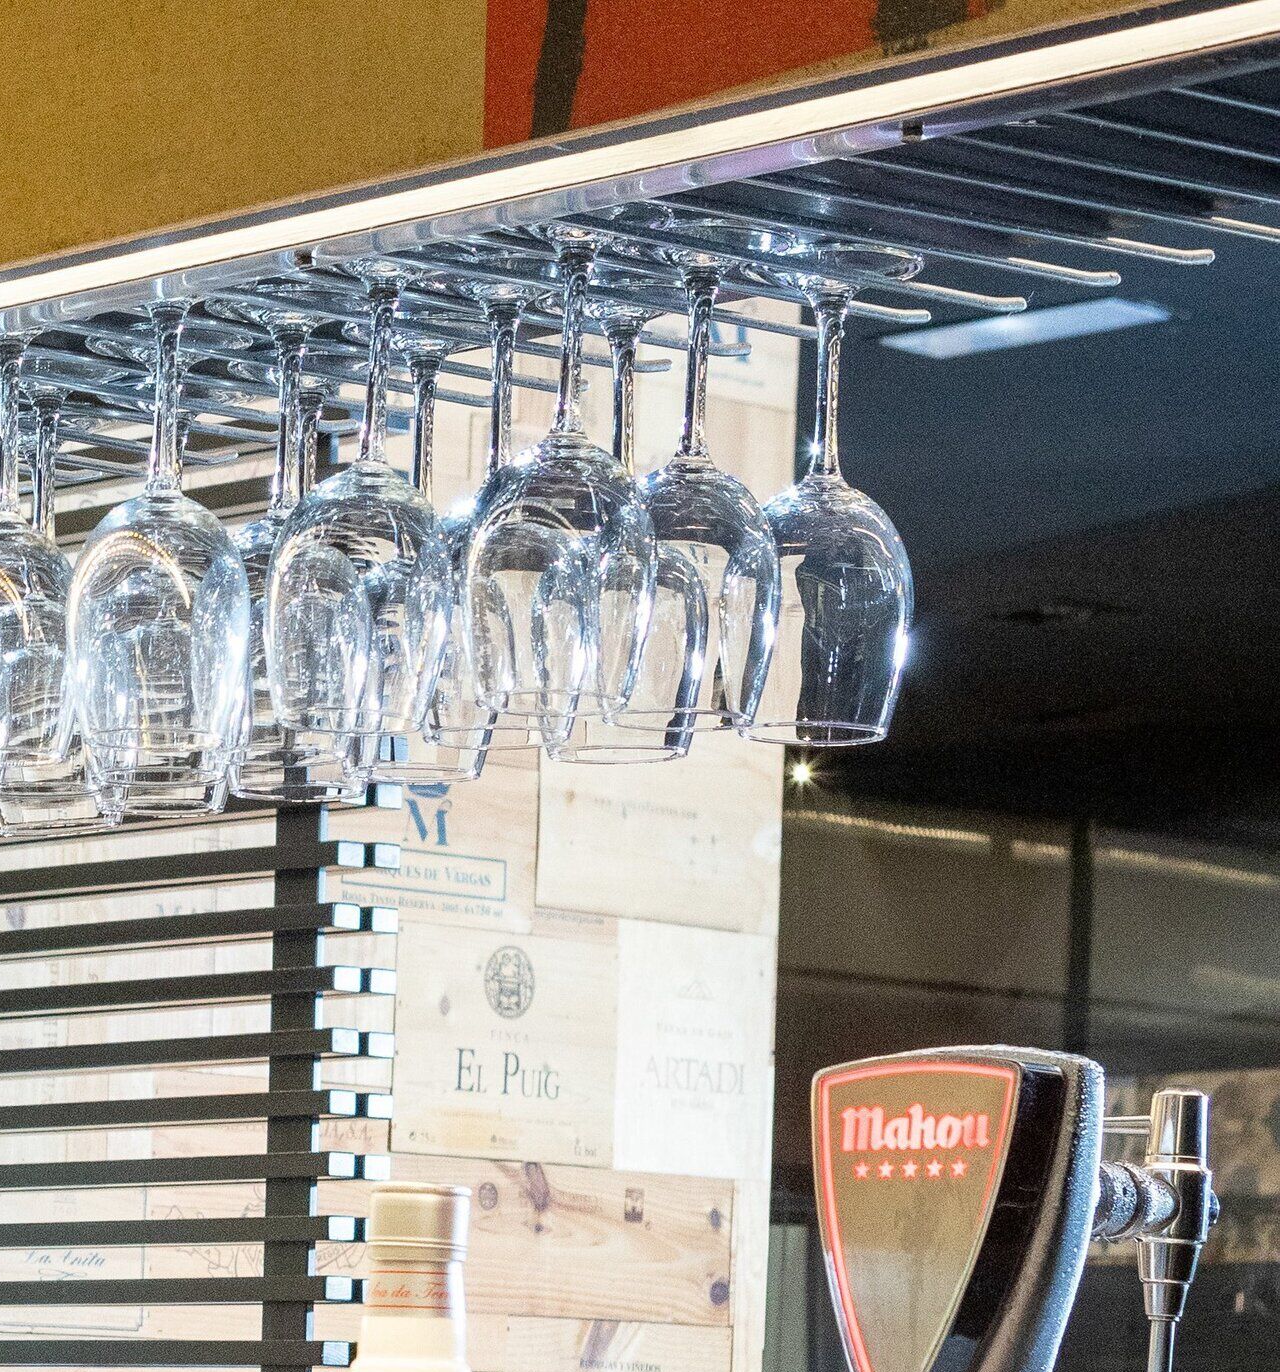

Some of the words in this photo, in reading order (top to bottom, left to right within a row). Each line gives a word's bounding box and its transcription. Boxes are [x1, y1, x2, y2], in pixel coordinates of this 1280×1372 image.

[490, 1029, 530, 1043] FINCA
[454, 1047, 488, 1095] EL
[500, 1051, 561, 1101] PUIG
[641, 1053, 746, 1096] ARTADI
[840, 1103, 994, 1153] Mahou
